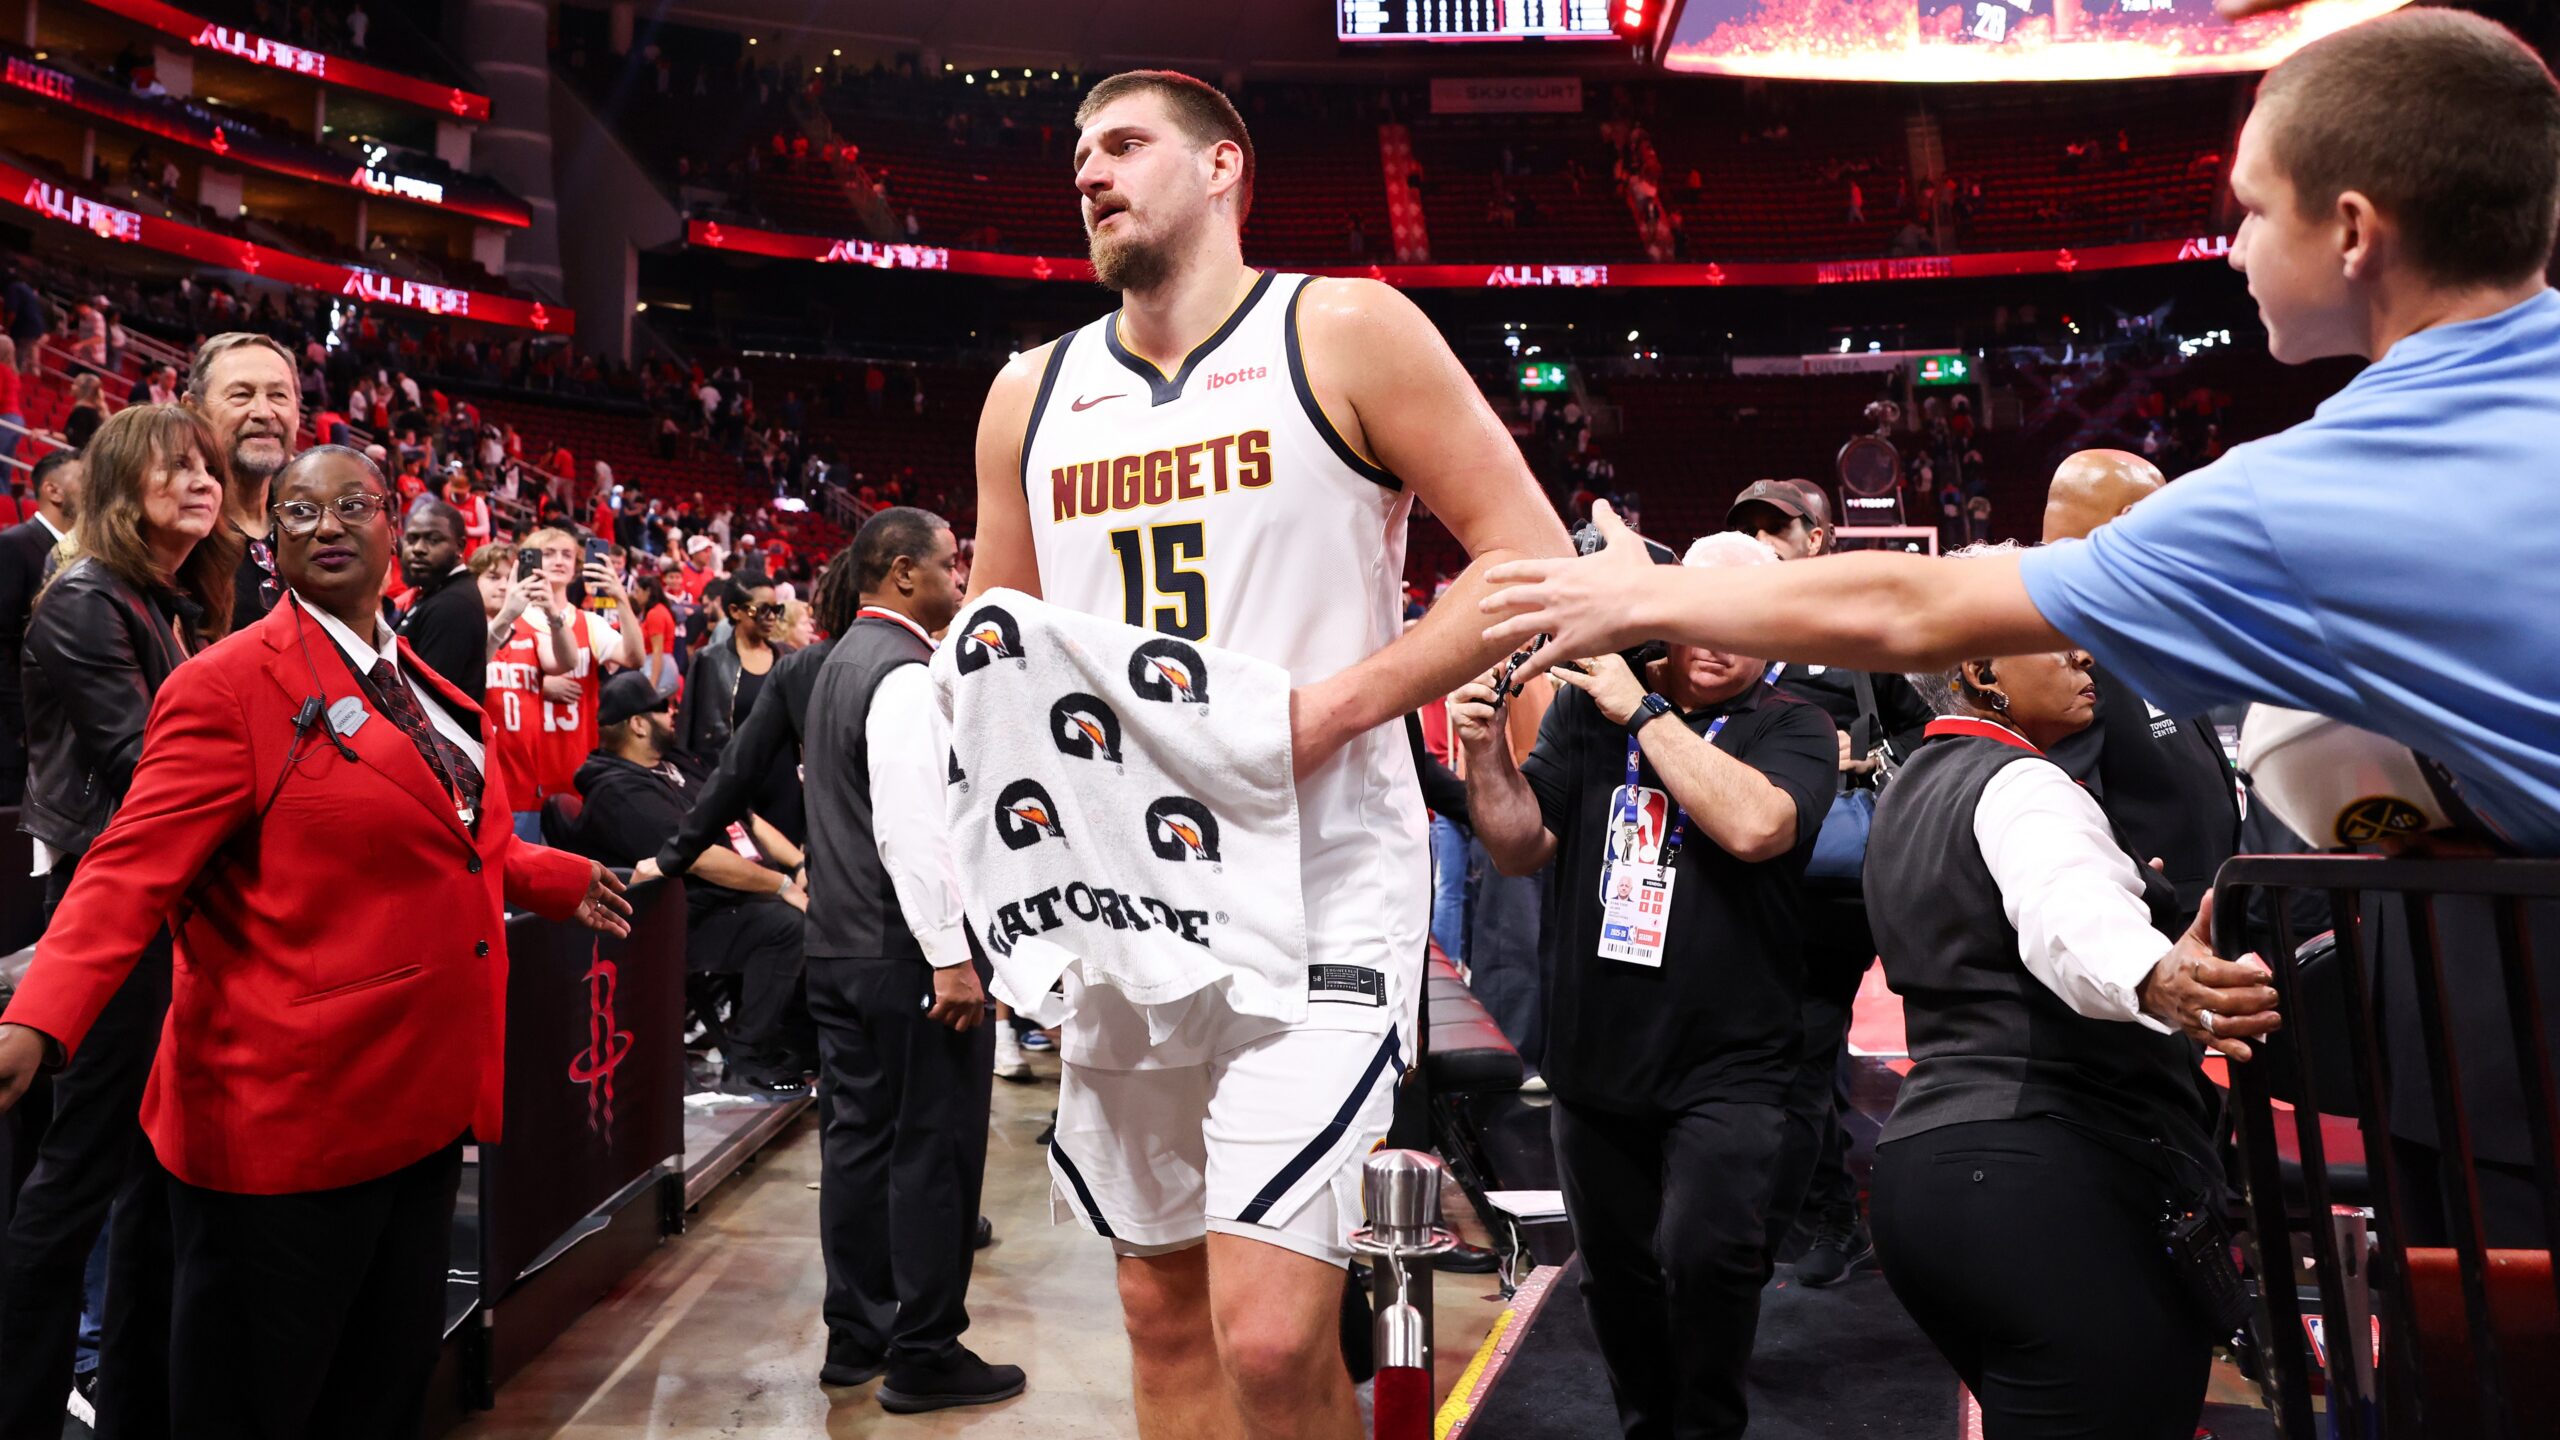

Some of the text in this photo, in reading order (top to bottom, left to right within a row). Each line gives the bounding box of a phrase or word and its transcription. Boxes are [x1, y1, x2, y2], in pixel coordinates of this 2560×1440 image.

[199, 23, 256, 60] ALL
[351, 166, 393, 195] ALL
[24, 178, 71, 221] ALL
[828, 240, 884, 263] ALL
[2178, 235, 2232, 260] ALL
[1486, 265, 1541, 286] ALL
[1817, 256, 1951, 284] HOUSTON ROCKETS
[343, 271, 401, 303] ALL
[1207, 366, 1267, 391] ibotta
[1051, 429, 1273, 524] NUGGETS
[1109, 519, 1210, 643] 15
[543, 699, 579, 732] 13
[2149, 718, 2175, 731] TOYOTA
[2152, 725, 2178, 739] CENTER
